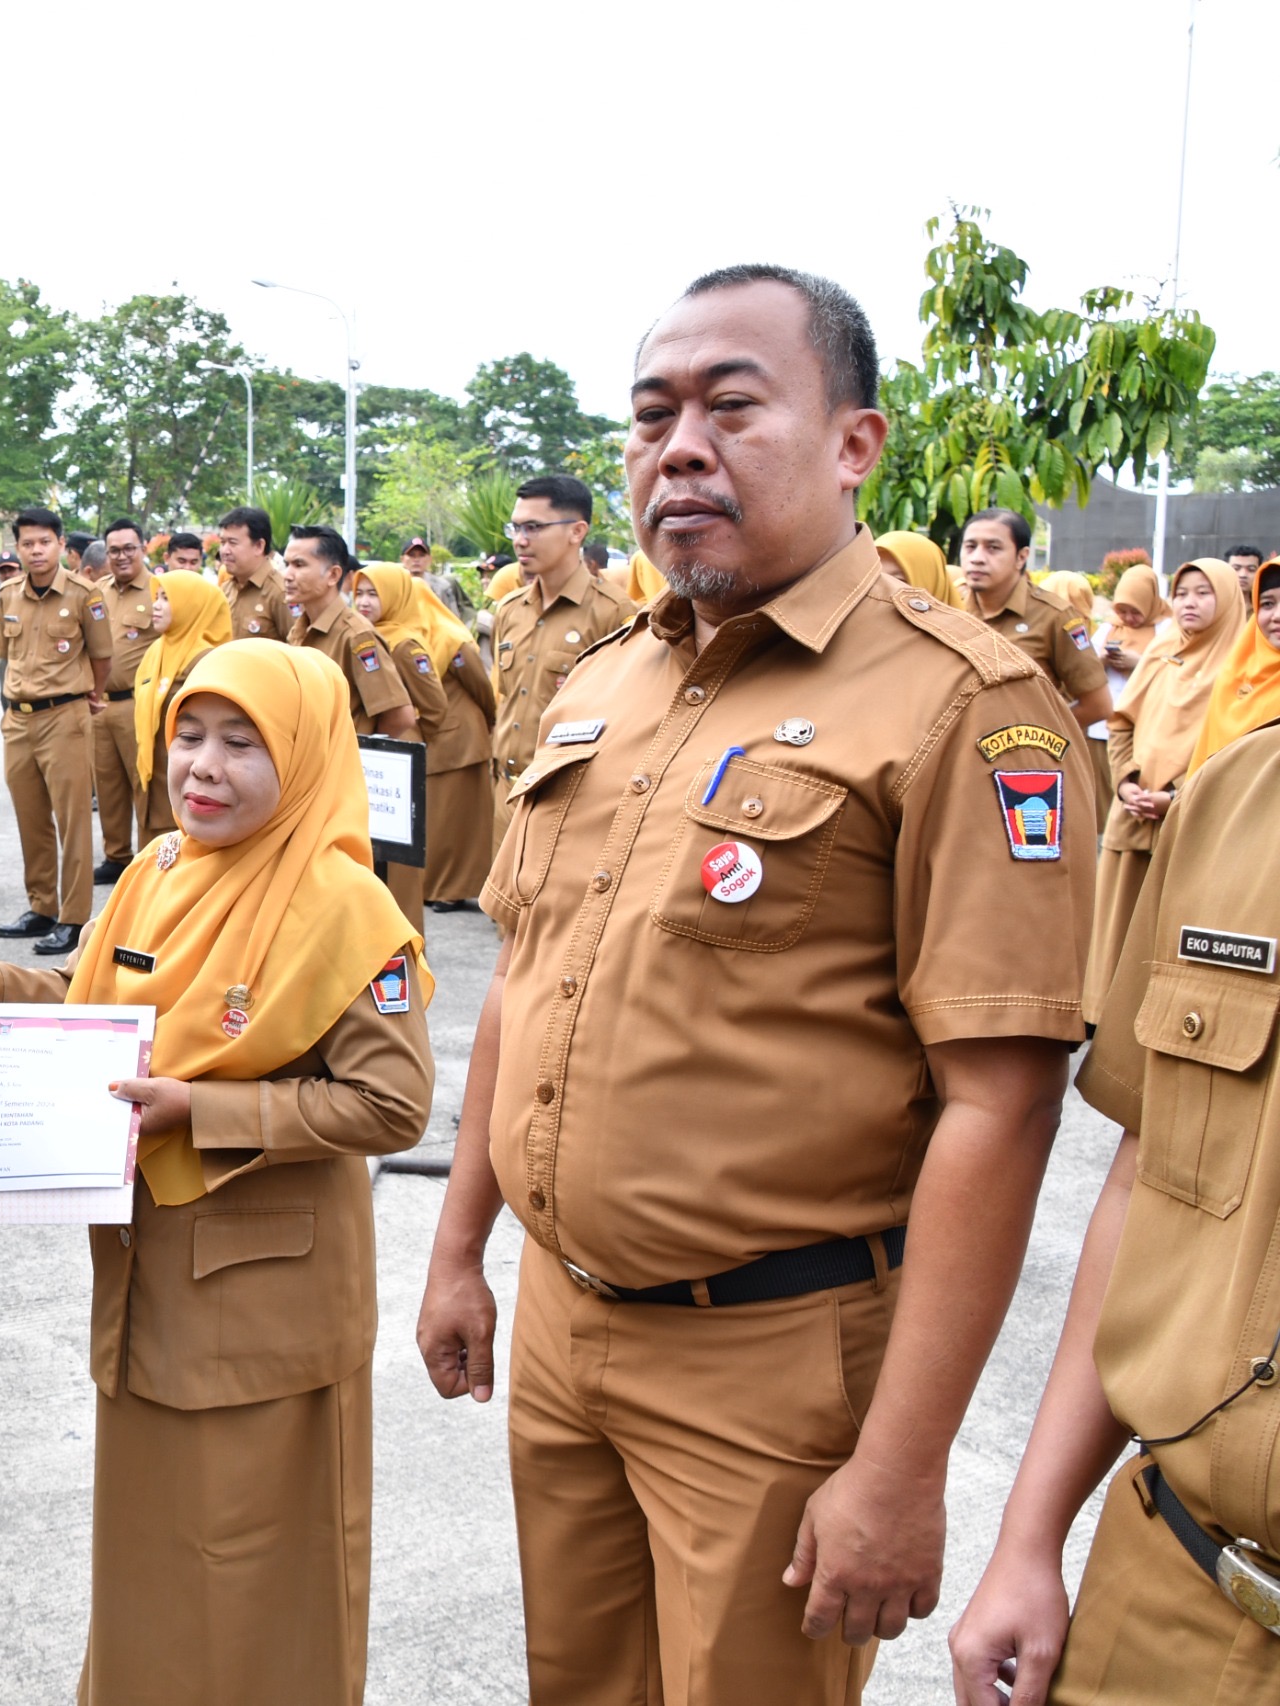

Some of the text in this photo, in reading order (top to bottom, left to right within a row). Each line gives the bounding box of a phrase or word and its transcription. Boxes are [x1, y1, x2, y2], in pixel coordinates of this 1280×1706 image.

[983, 729, 1063, 755] KOTA PADANG
[395, 787, 401, 799] &
[709, 850, 735, 872] Saya
[720, 862, 743, 883] Anti
[720, 868, 756, 897] Sogok
[119, 953, 146, 966] YEYENITA
[1186, 937, 1262, 961] EKO SAPUTRA
